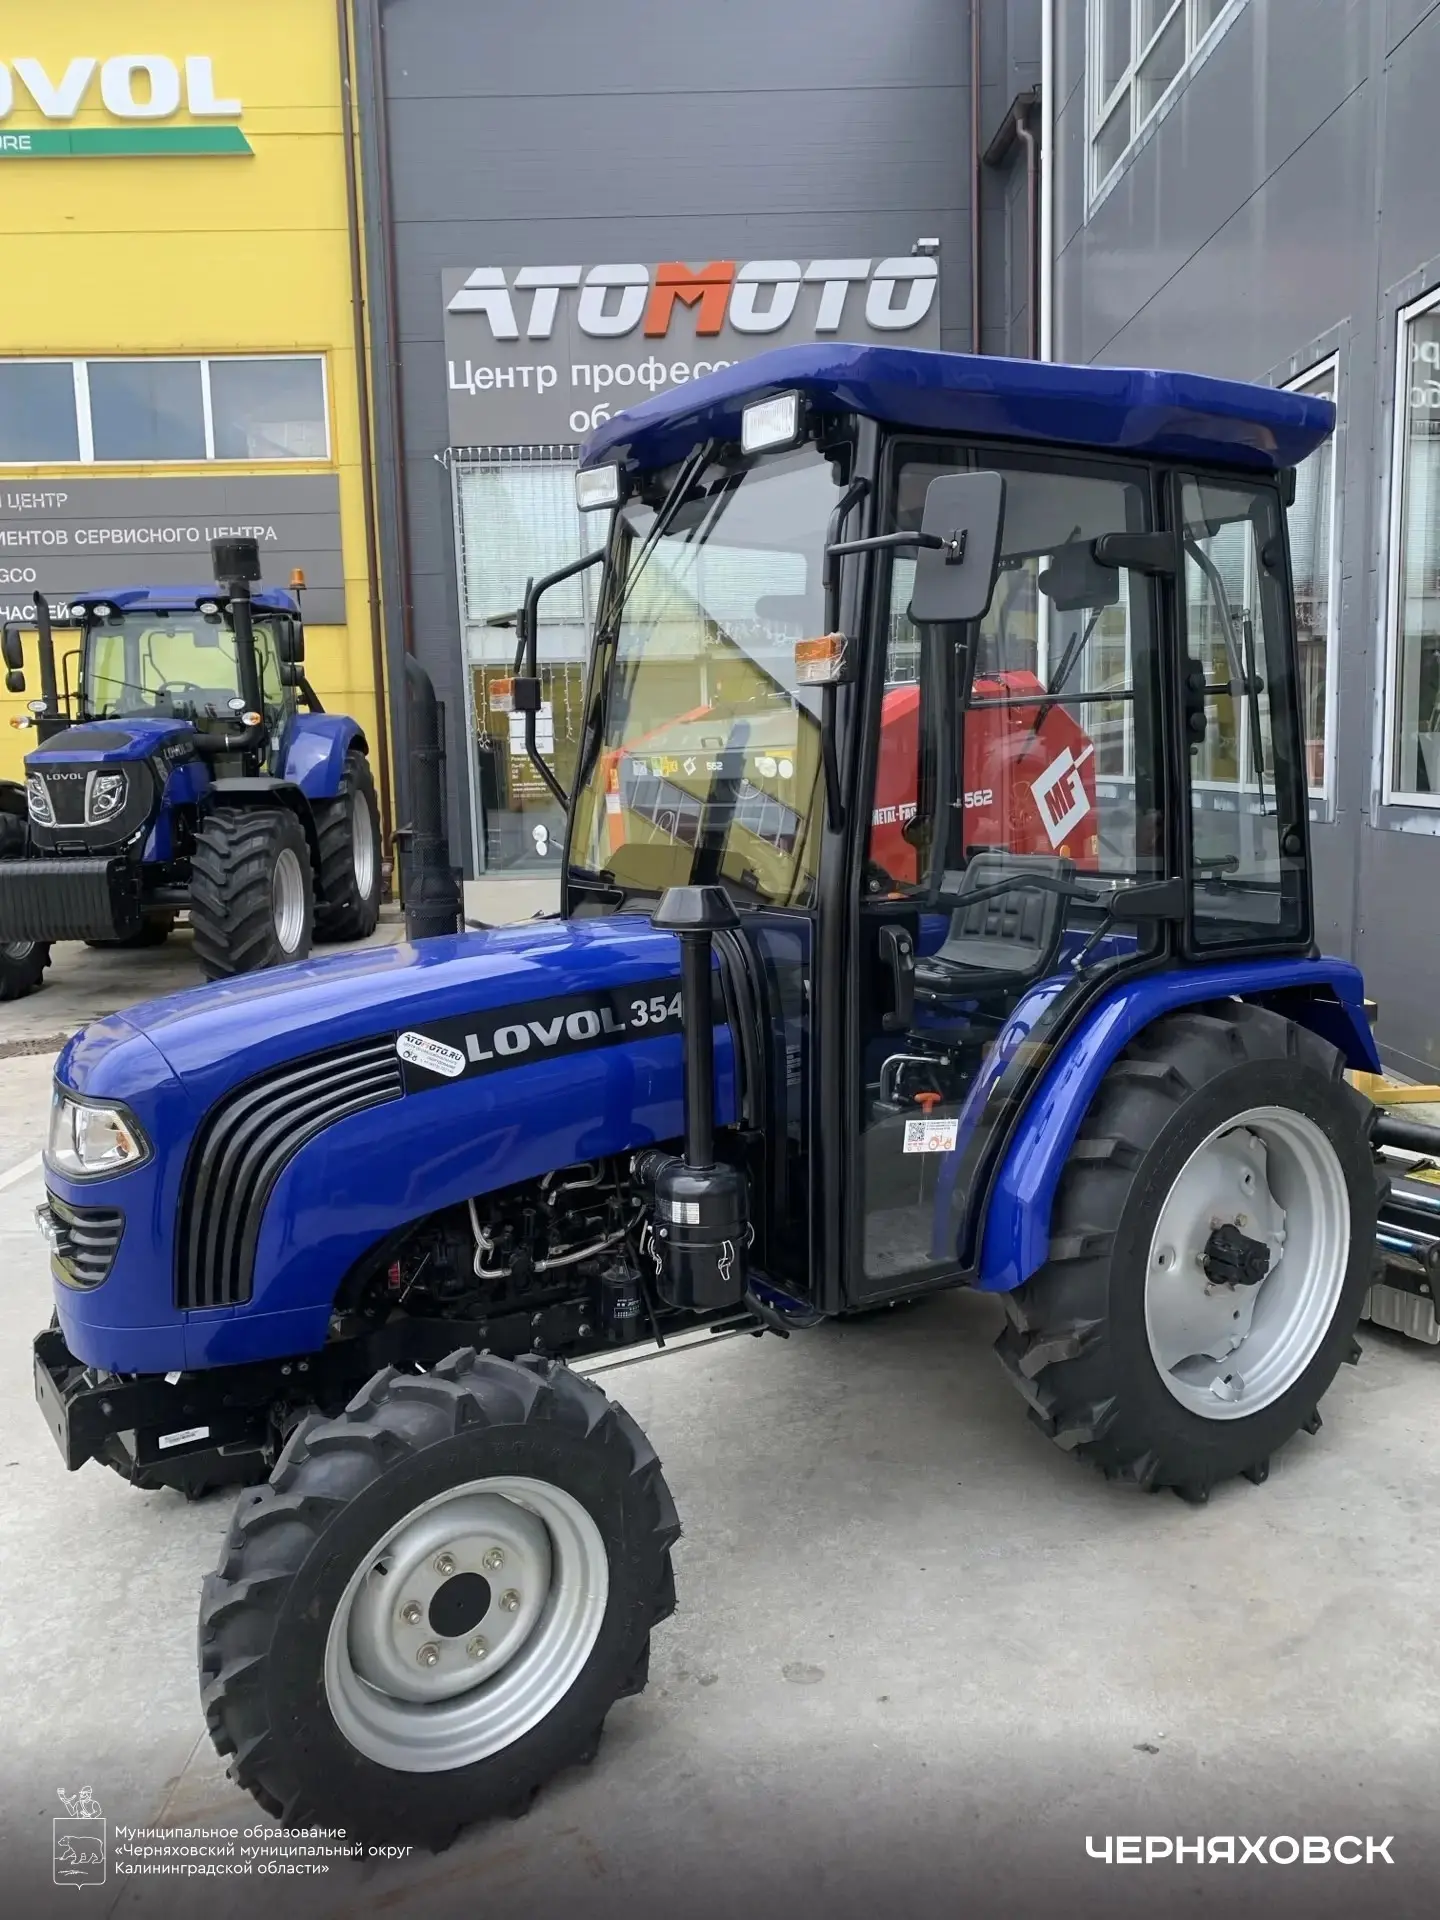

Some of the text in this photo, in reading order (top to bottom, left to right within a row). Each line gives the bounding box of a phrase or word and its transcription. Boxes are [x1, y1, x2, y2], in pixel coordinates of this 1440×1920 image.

[0, 54, 242, 119] VOL
[0, 135, 32, 150] RE
[446, 256, 939, 341] ATOMOTO
[448, 360, 558, 395] Центр
[569, 402, 626, 433] об
[7, 492, 68, 512] ЦЕНТР
[74, 527, 200, 545] СЕРВИСНОГО
[205, 525, 278, 542] ЦЕНТРА
[0, 601, 70, 620] ЧАСЕЙ
[46, 772, 85, 781] LOVOL
[964, 788, 994, 809] 562
[464, 1007, 626, 1063] LOVOL
[630, 991, 683, 1028] 354
